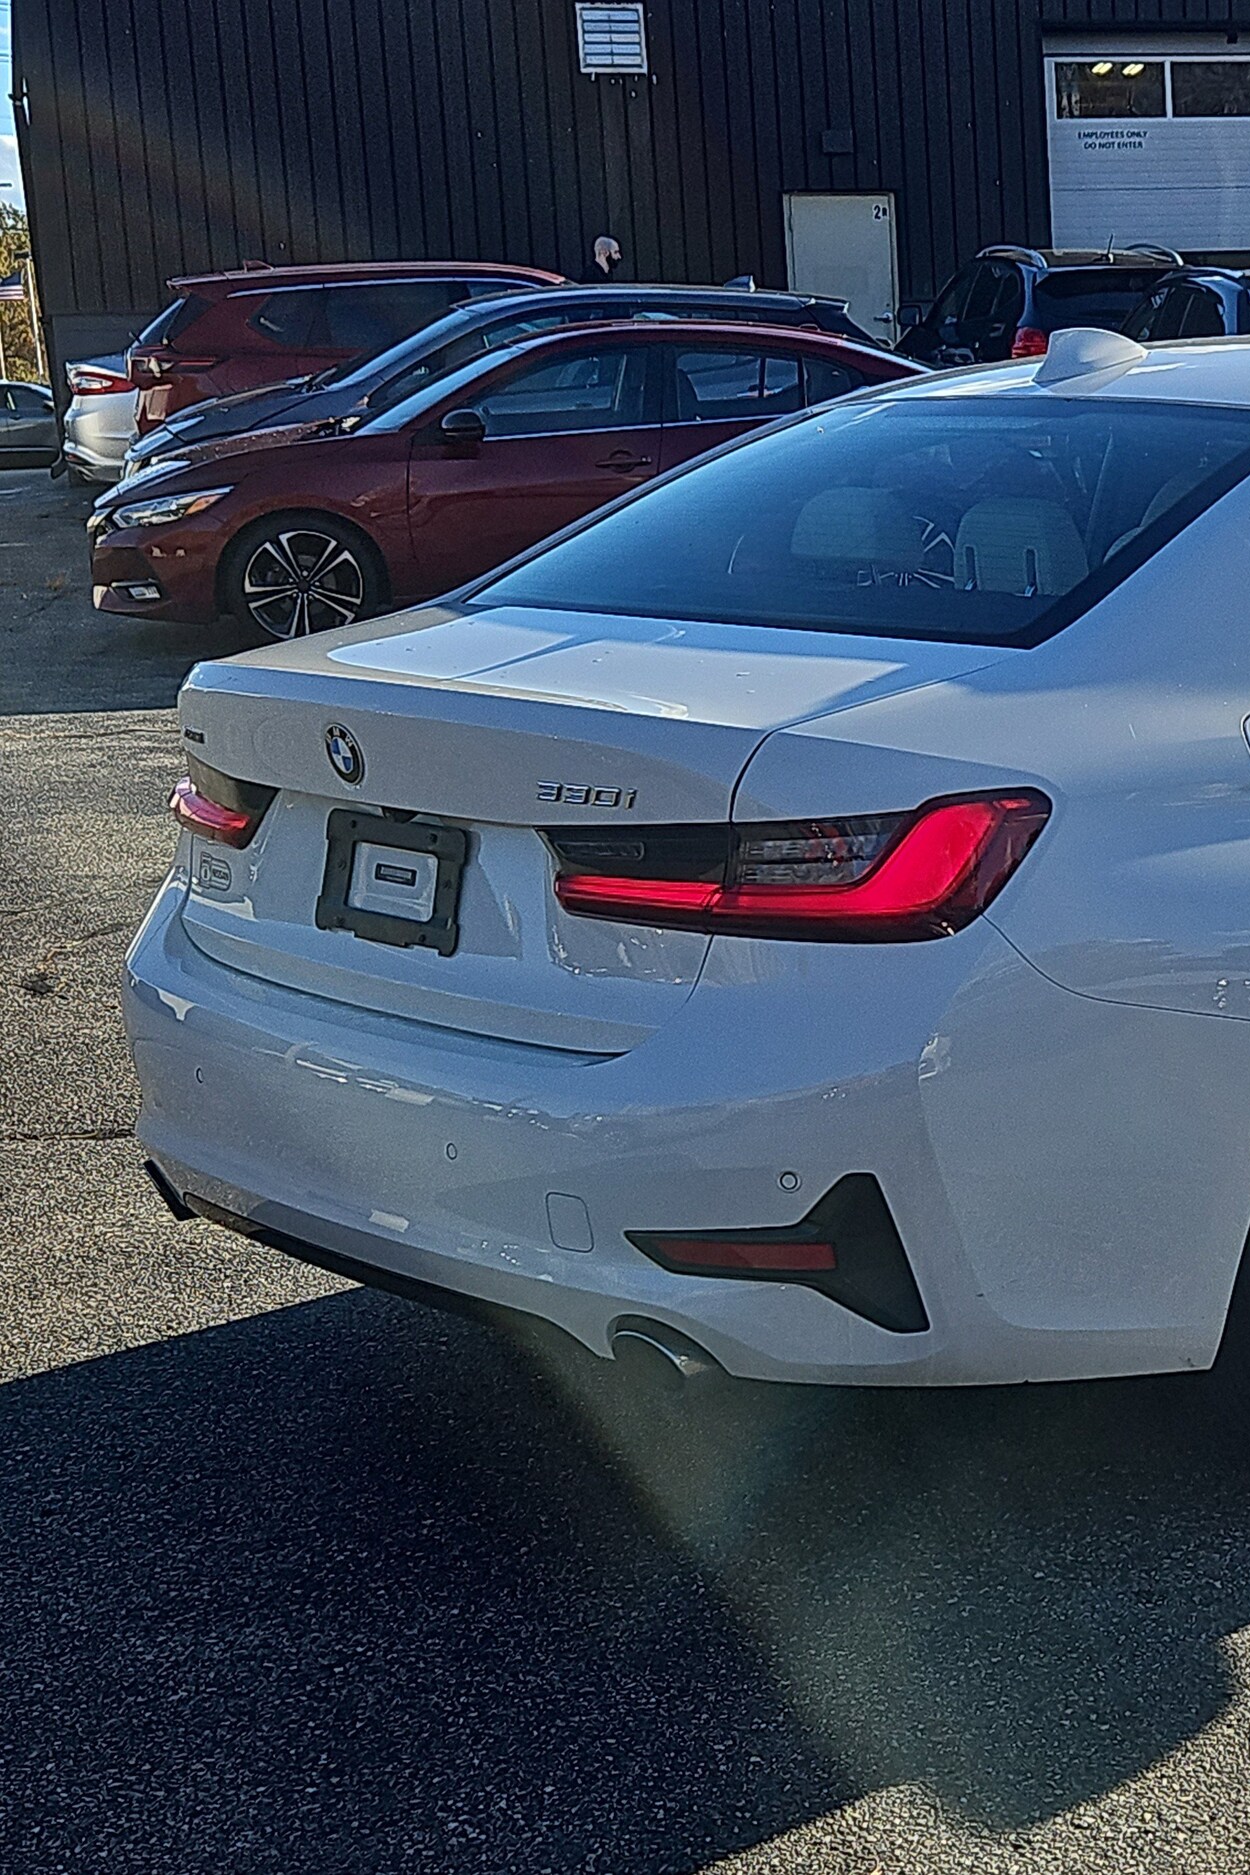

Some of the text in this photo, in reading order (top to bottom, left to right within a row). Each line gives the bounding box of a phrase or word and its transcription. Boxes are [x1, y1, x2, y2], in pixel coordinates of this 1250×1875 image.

[1077, 130, 1148, 139] EMPLOYEES ONLY
[1083, 141, 1143, 150] DO NOT ENTER
[537, 780, 637, 809] 330i
